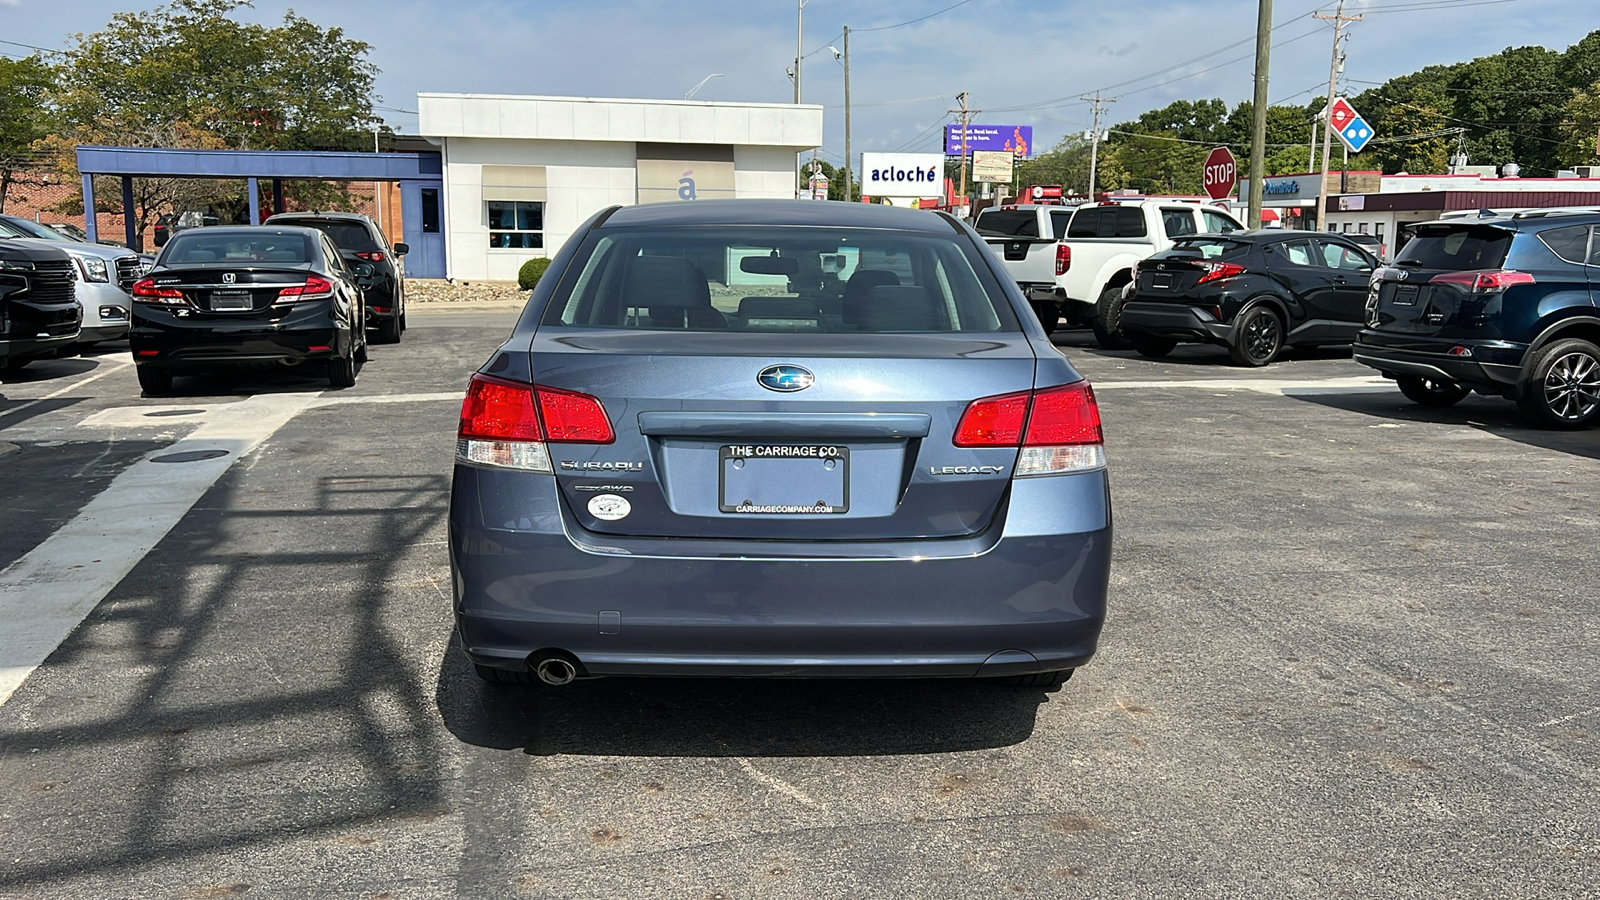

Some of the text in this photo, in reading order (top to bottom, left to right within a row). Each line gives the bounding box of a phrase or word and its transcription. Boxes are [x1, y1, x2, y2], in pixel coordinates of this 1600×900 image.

[872, 166, 936, 182] acloché
[1206, 162, 1234, 185] STOP
[730, 446, 840, 456] THE CARRIAGE CO.
[560, 460, 642, 472] SUBARU
[930, 466, 1004, 475] LEGACY
